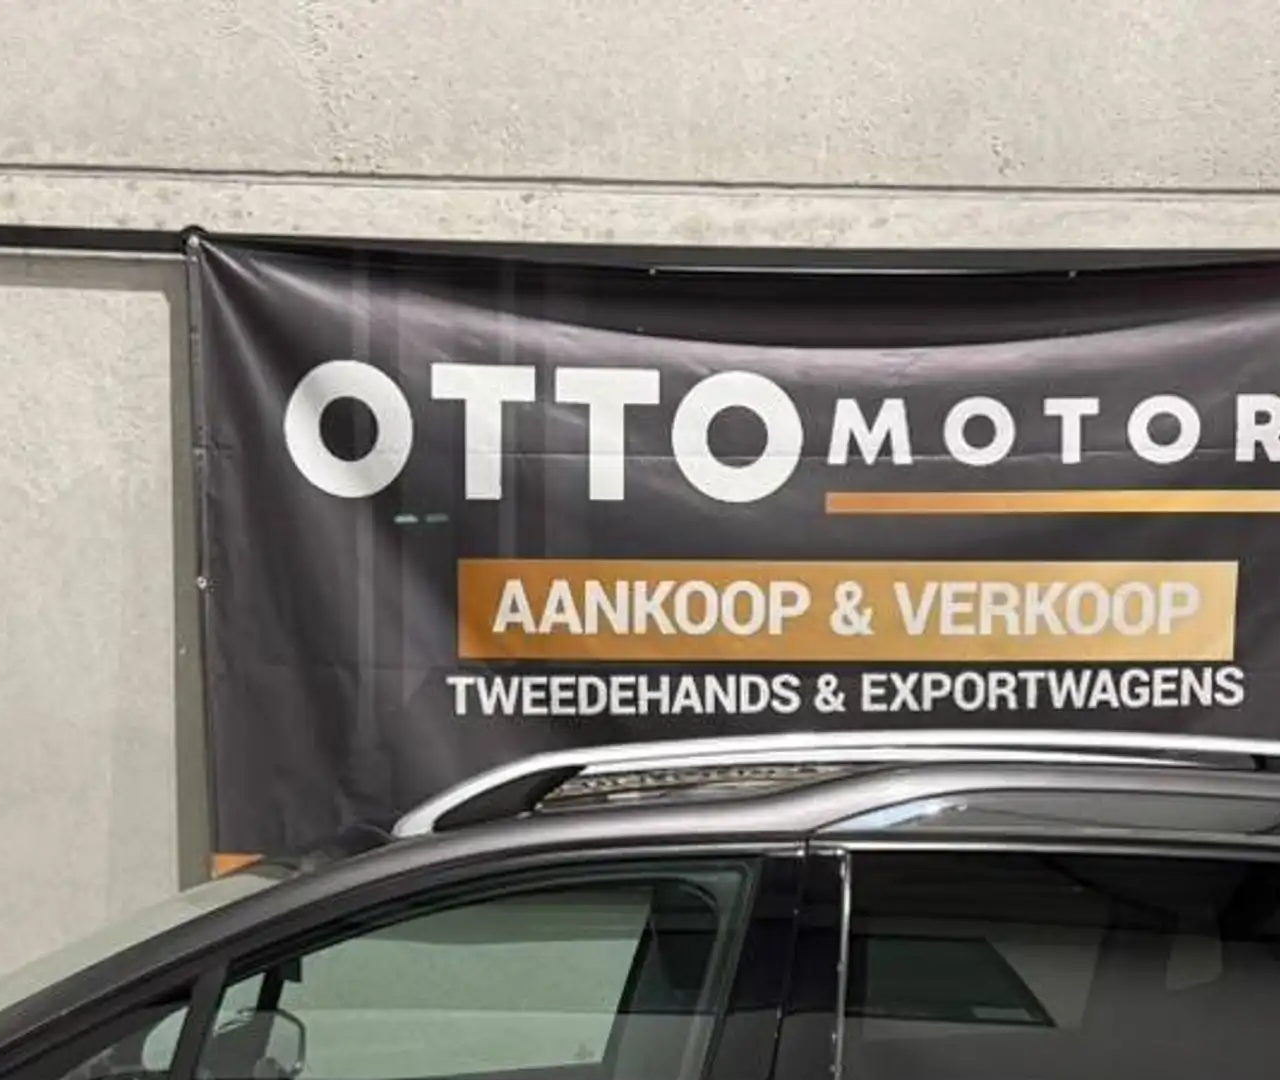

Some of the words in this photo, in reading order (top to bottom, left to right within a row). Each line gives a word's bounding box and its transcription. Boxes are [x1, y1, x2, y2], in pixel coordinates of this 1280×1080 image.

[283, 359, 804, 503] OTTO
[492, 580, 811, 635] AANKOOP
[832, 581, 873, 636] &
[896, 580, 1203, 636] VERKOOP
[446, 673, 801, 716] TWEEDEHANDS
[814, 673, 847, 713] &
[861, 666, 1245, 713] EXPORTWAGENS
